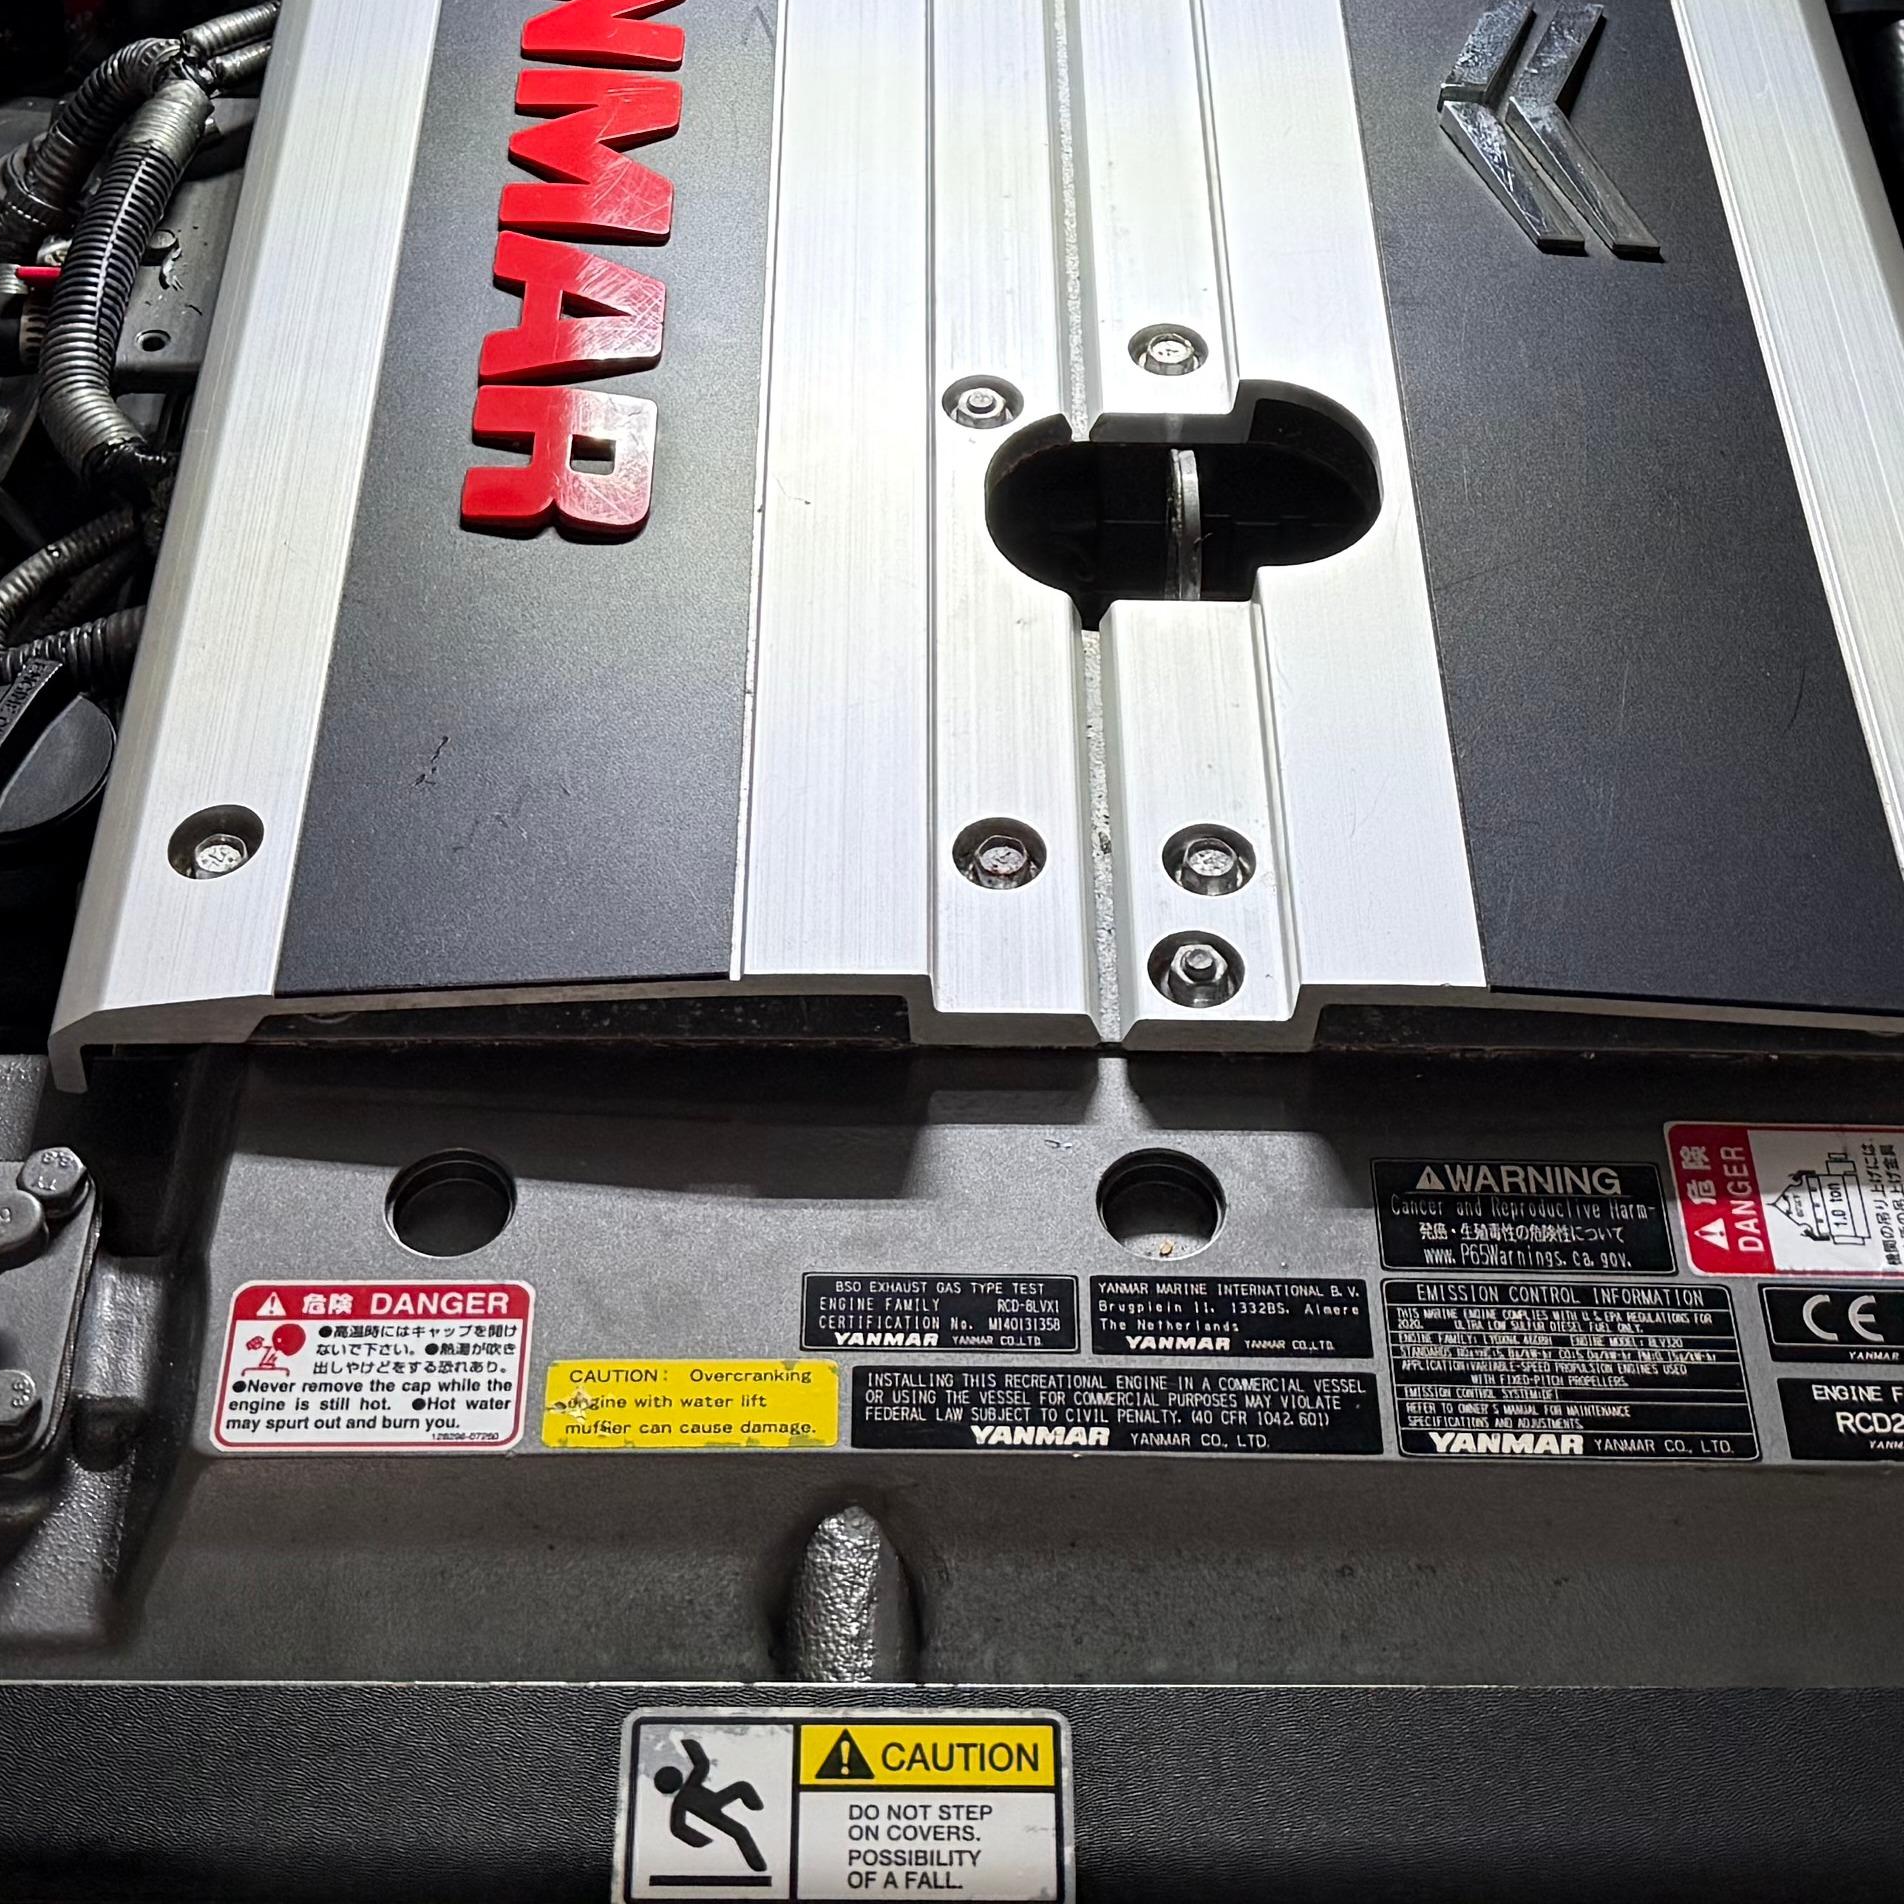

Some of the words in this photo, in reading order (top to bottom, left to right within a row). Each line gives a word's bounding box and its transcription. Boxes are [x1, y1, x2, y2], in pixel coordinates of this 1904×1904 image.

[1445, 1165, 1622, 1195] WARNING
[1681, 1145, 1718, 1206] 危険
[1721, 1145, 1765, 1254] DANGER
[1829, 1182, 1843, 1203] ton
[1392, 1194, 1442, 1216] Cancer
[1456, 1198, 1482, 1216] and
[1492, 1197, 1600, 1220] Reproductive
[836, 1281, 861, 1293] BSO
[870, 1281, 927, 1293] EXHAUST
[936, 1283, 961, 1294] GAS
[971, 1283, 1003, 1294] TYPE
[1012, 1283, 1044, 1295] TEST
[1098, 1283, 1149, 1294] YANMAR
[1156, 1283, 1208, 1295] MARINE
[1217, 1284, 1324, 1297] INTERNATIONAL
[1417, 1284, 1499, 1302] EMISSION
[1508, 1286, 1580, 1304] CONTROL
[1594, 1287, 1705, 1307] INFORMATION
[302, 1293, 353, 1315] 危険
[370, 1292, 509, 1315] DANGER
[820, 1297, 874, 1311] ENGINE
[886, 1298, 940, 1312] FAMILY
[1099, 1300, 1182, 1314] Brugplein
[1304, 1303, 1359, 1315] Almere
[819, 1316, 940, 1330] CERTIFICATION
[950, 1318, 974, 1330] No.
[1100, 1318, 1127, 1331] The
[1137, 1319, 1239, 1332] Netherlands
[833, 1332, 939, 1347] YANMAR
[952, 1336, 993, 1345] YANMAR
[1125, 1335, 1231, 1351] YANMAR
[1244, 1339, 1285, 1349] YANMAR
[316, 1342, 416, 1357] ないで下さい。
[1849, 1350, 1900, 1361] YANMAR
[313, 1361, 508, 1375] 出しやけどをする恐れあり。
[690, 1369, 812, 1384] Overcranking
[248, 1380, 295, 1393] Never
[302, 1381, 363, 1393] remove
[370, 1379, 394, 1392] the
[402, 1381, 431, 1395] cap
[438, 1379, 480, 1392] while
[488, 1379, 513, 1392] the
[868, 1373, 954, 1387] INSTALLING
[963, 1373, 996, 1388] THIS
[1005, 1374, 1107, 1389] RECREATIONAL
[1116, 1375, 1168, 1390] ENGINE
[1178, 1376, 1193, 1391] IN
[1202, 1377, 1211, 1391] A
[1218, 1377, 1304, 1393] COMMERCIAL
[1314, 1379, 1366, 1393] VESSEL
[635, 1396, 673, 1408] with
[681, 1396, 733, 1408] water
[741, 1394, 767, 1407] lift
[865, 1391, 883, 1404] OR
[892, 1391, 937, 1404] USING
[946, 1391, 970, 1405] THE
[979, 1392, 1031, 1405] VESSEL
[1040, 1392, 1066, 1405] FOR
[1074, 1392, 1160, 1407] COMMERCIAL
[1168, 1394, 1238, 1408] PURPOSES
[1246, 1395, 1272, 1409] MAY
[1281, 1396, 1342, 1410] VIOLATE
[1811, 1384, 1884, 1402] ENGINE
[228, 1399, 286, 1414] engine
[295, 1398, 309, 1411] is
[319, 1398, 350, 1411] still
[360, 1398, 391, 1411] hot.
[427, 1398, 456, 1410] Hot
[466, 1399, 511, 1410] water
[226, 1418, 261, 1432] may
[265, 1417, 309, 1432] spurt
[314, 1417, 341, 1429] out
[346, 1416, 376, 1429] and
[382, 1416, 419, 1429] burn
[426, 1418, 461, 1432] you.
[865, 1406, 926, 1421] FEDERAL
[936, 1407, 963, 1422] LAW
[971, 1407, 1030, 1422] SUBJECT
[1040, 1408, 1058, 1422] TO
[1065, 1408, 1109, 1423] CIVIL
[1117, 1409, 1181, 1424] PENALTY.
[1192, 1410, 1213, 1425] (40
[1220, 1410, 1247, 1425] CFR
[640, 1424, 672, 1434] can
[680, 1423, 733, 1434] cause
[740, 1421, 816, 1436] damage.
[970, 1425, 1110, 1446] YANMAR
[1131, 1433, 1191, 1446] YANMAR
[1237, 1434, 1269, 1448] LTD.
[1428, 1432, 1584, 1454] YANMAR
[1595, 1438, 1655, 1453] YANMAR
[1701, 1439, 1735, 1454] LTD.
[881, 1741, 1040, 1774] CAUTION
[848, 1804, 880, 1821] DO
[886, 1804, 930, 1821] NOT
[937, 1803, 993, 1821] STEP
[848, 1824, 880, 1842] ON
[886, 1824, 982, 1843] COVERS.
[848, 1849, 982, 1867] POSSIBILITY
[847, 1871, 877, 1889] OF
[884, 1871, 898, 1889] A
[904, 1871, 963, 1890] FALL.
